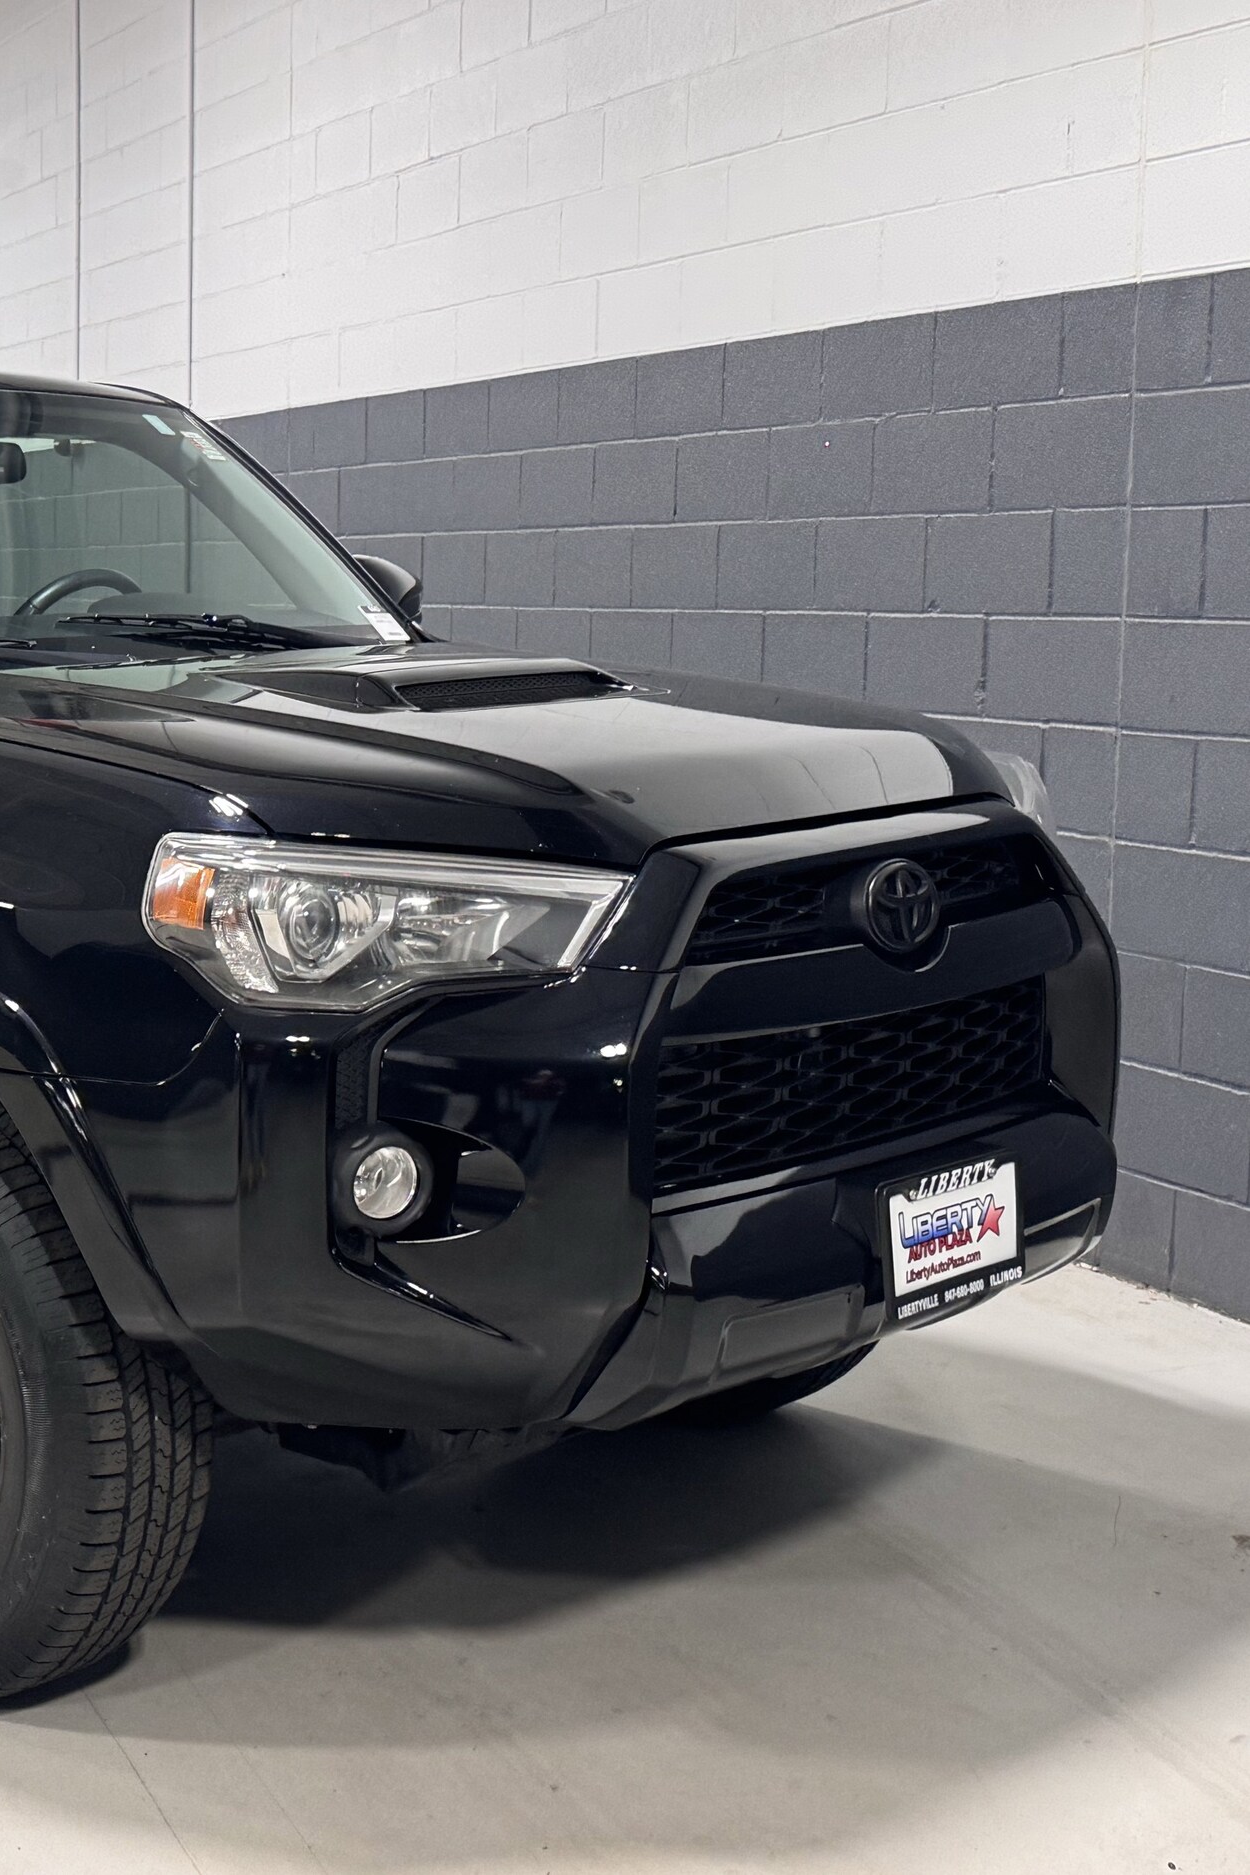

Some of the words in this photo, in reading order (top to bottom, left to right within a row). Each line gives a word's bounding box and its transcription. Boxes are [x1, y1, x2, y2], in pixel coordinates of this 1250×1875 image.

[916, 1158, 996, 1200] LIBERTY
[898, 1193, 994, 1249] LIBERTY
[906, 1250, 982, 1284] LibertyAutoPlaza.com
[908, 1239, 936, 1264] AUTO
[938, 1228, 973, 1253] PLAZA
[897, 1293, 939, 1320] LIBERTYVILLE
[989, 1265, 1023, 1287] ILLINOIS
